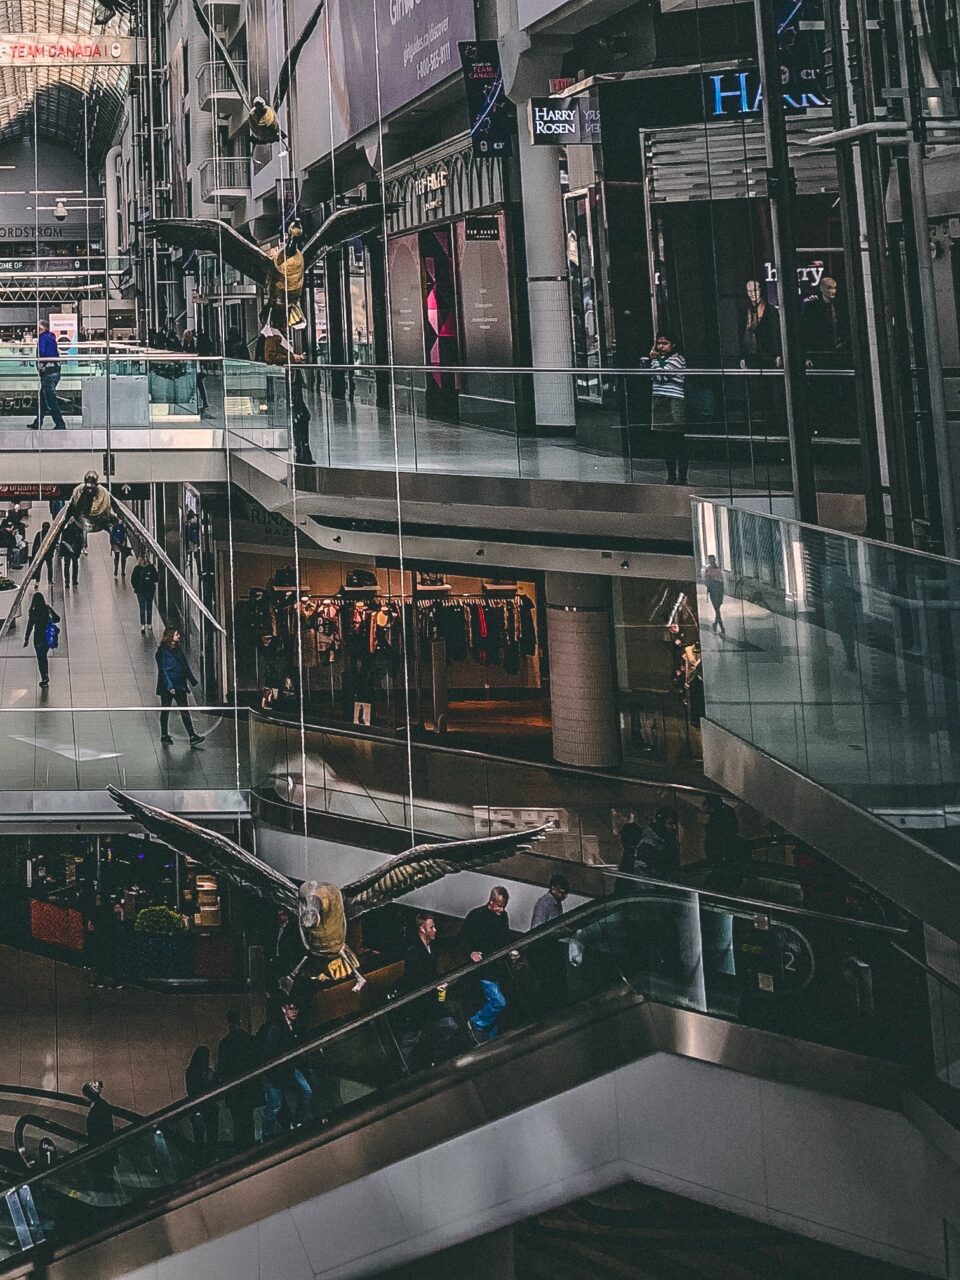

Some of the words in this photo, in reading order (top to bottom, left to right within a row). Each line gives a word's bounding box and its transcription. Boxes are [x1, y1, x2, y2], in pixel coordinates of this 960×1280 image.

[11, 44, 45, 58] TEAM
[48, 44, 101, 58] CANADA
[534, 107, 576, 121] HARRY
[535, 121, 576, 134] ROSEN
[14, 261, 23, 269] OF
[764, 262, 824, 286] hrry
